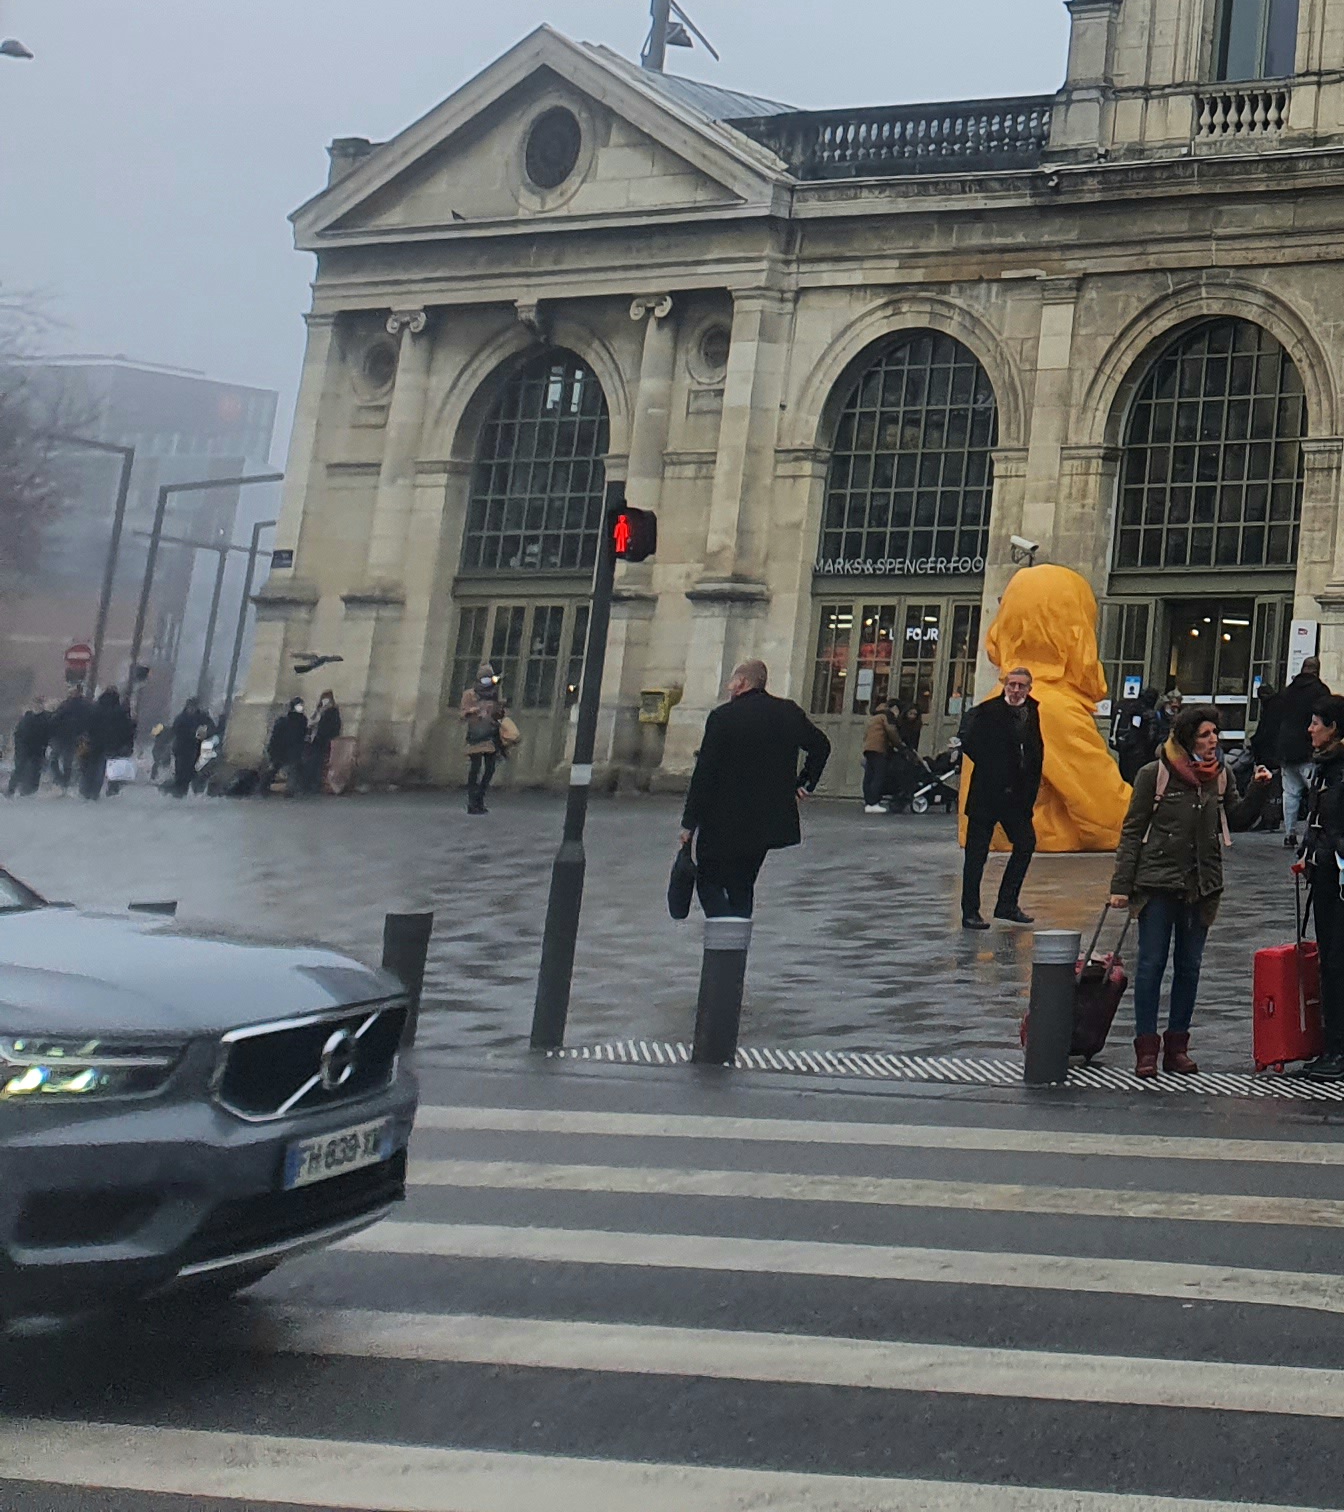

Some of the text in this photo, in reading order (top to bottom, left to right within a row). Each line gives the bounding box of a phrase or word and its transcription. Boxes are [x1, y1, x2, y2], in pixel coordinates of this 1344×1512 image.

[813, 558, 863, 575] MARKS
[875, 556, 948, 574] SPENCER
[949, 556, 984, 575] FOO
